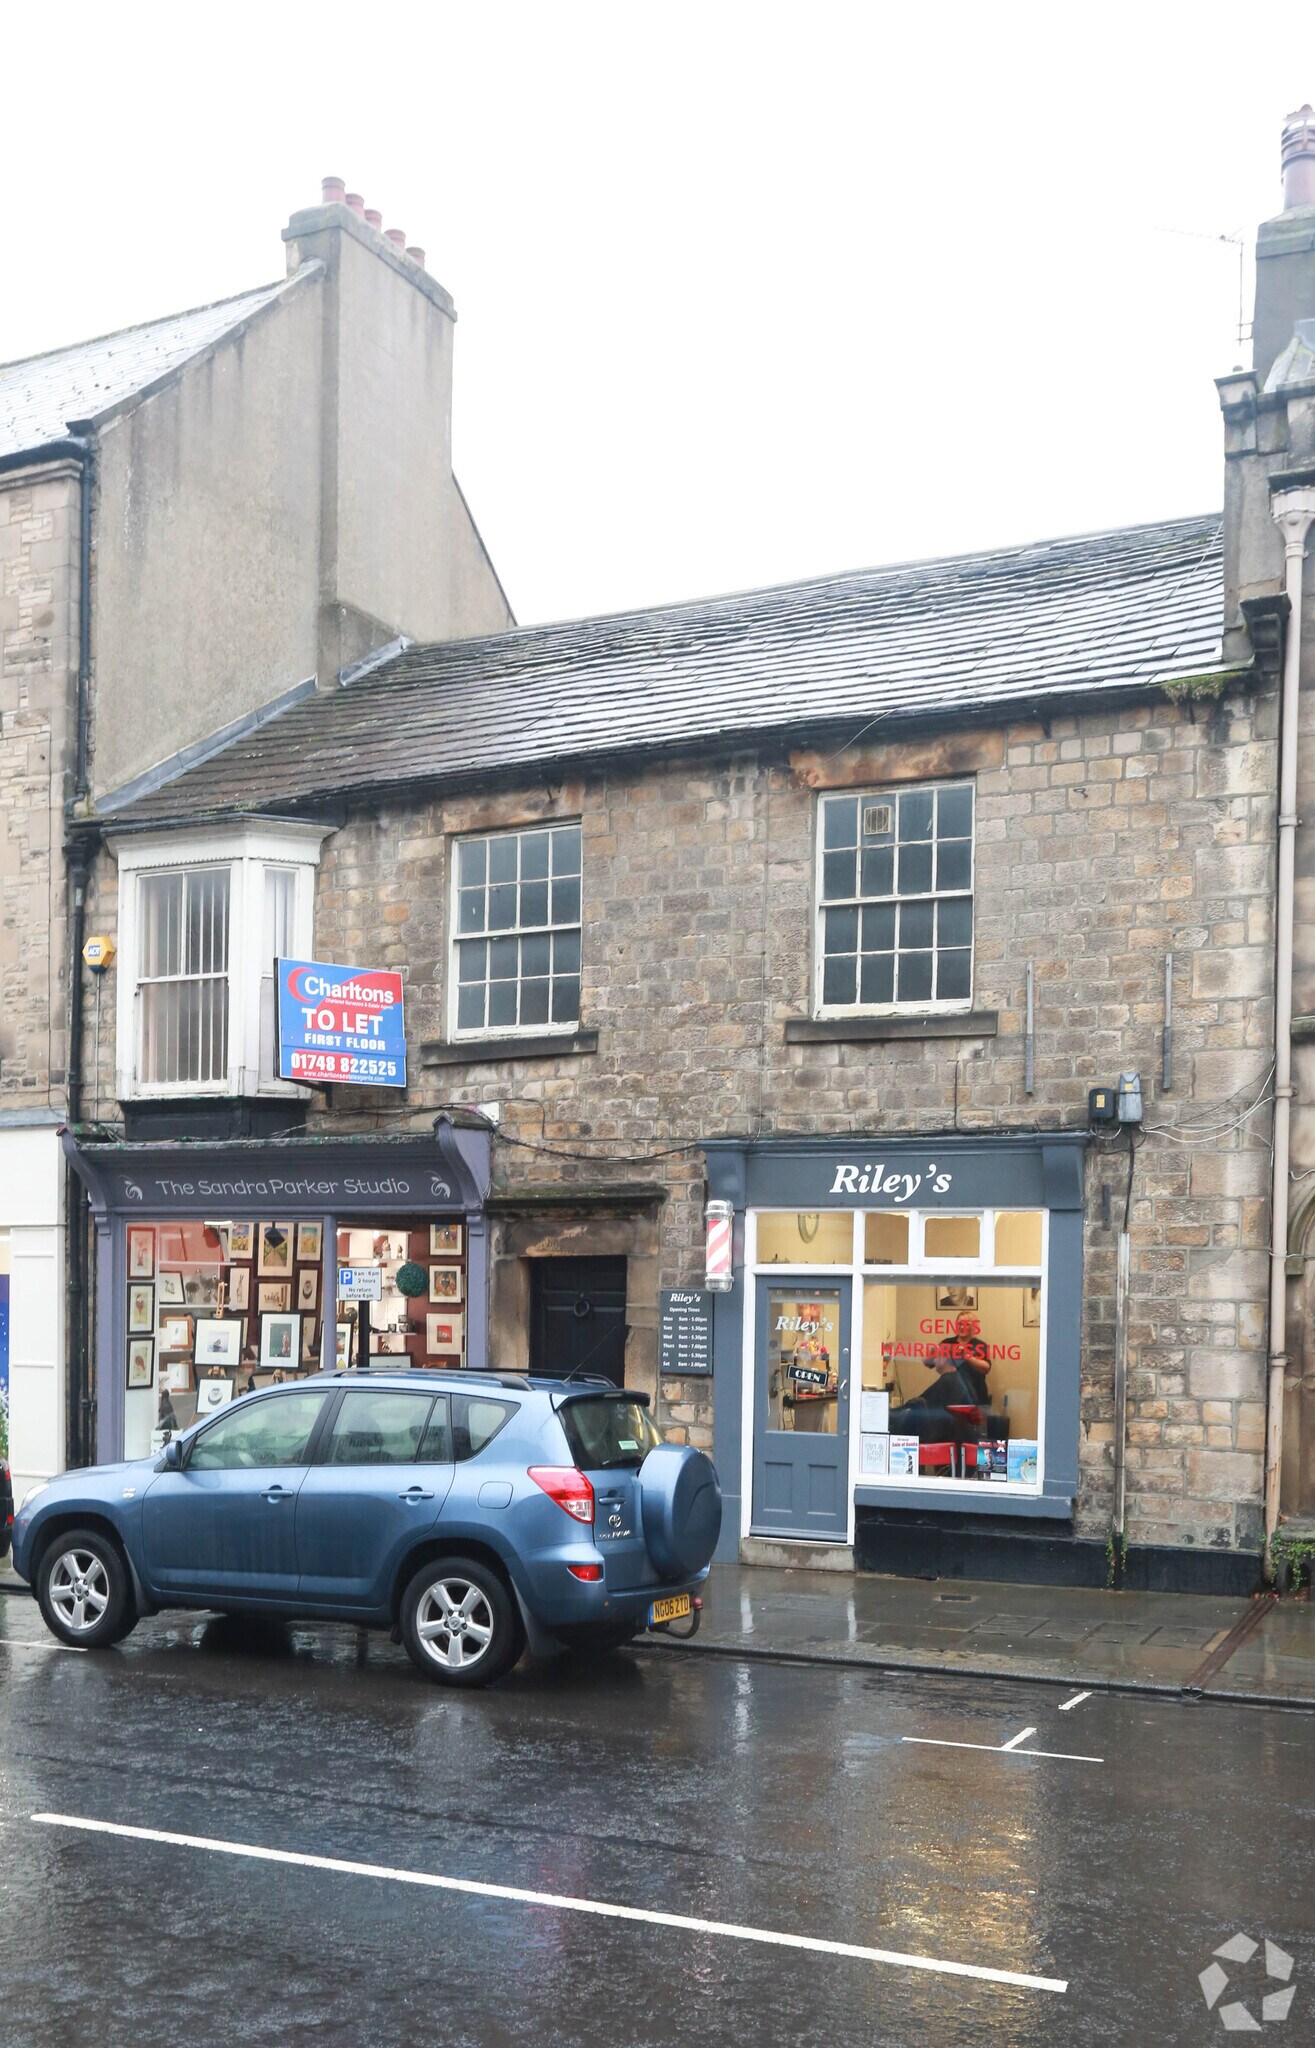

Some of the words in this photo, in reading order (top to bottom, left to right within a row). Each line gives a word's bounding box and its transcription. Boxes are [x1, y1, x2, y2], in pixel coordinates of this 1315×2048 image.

[304, 976, 394, 1004] Charltons
[302, 1008, 335, 1030] TO
[342, 1012, 383, 1036] LET
[304, 1033, 342, 1047] FIRST
[346, 1037, 386, 1051] FLOOR
[290, 1053, 336, 1071] 01748
[340, 1057, 396, 1076] 822525
[156, 1180, 195, 1196] The
[198, 1179, 268, 1195] Sandra
[268, 1179, 339, 1195] Parker
[344, 1178, 410, 1194] Studio
[829, 1164, 952, 1202] Riley's
[919, 1318, 981, 1336] GENTS
[881, 1341, 1021, 1360] HAIRDRESSING
[795, 1369, 820, 1382] OPEN
[655, 1600, 674, 1618] NG06
